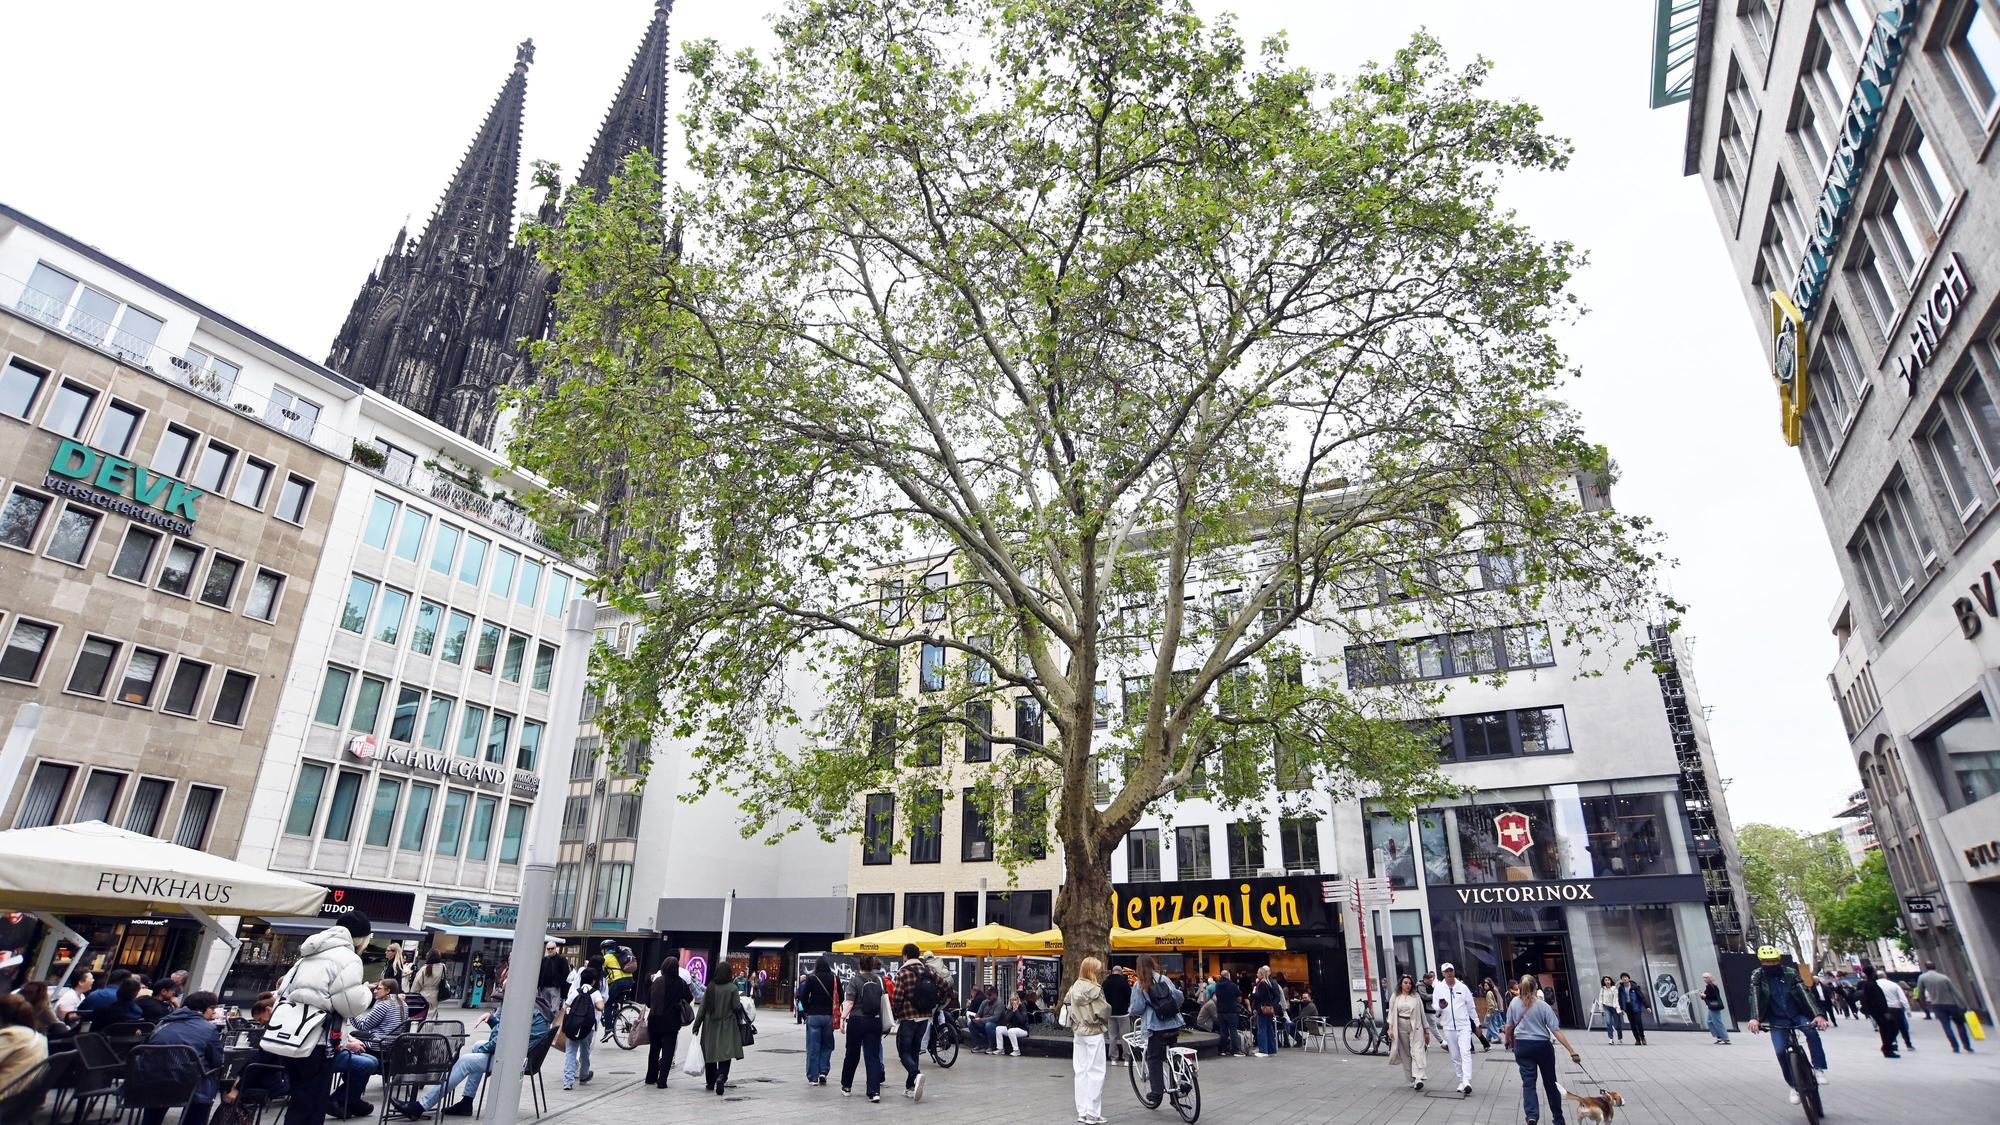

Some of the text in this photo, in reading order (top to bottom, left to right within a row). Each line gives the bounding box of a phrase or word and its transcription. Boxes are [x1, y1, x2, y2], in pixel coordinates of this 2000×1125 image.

[1909, 252, 1970, 369] HYGH
[43, 475, 194, 537] VERSICHERUNGEN
[50, 439, 203, 522] DEVK
[1951, 560, 2000, 640] BV
[96, 872, 233, 903] FUNKHAUS
[1111, 884, 1301, 929] erzenich
[1456, 884, 1594, 904] VICTORINOX
[1155, 937, 1184, 945] Merzenich
